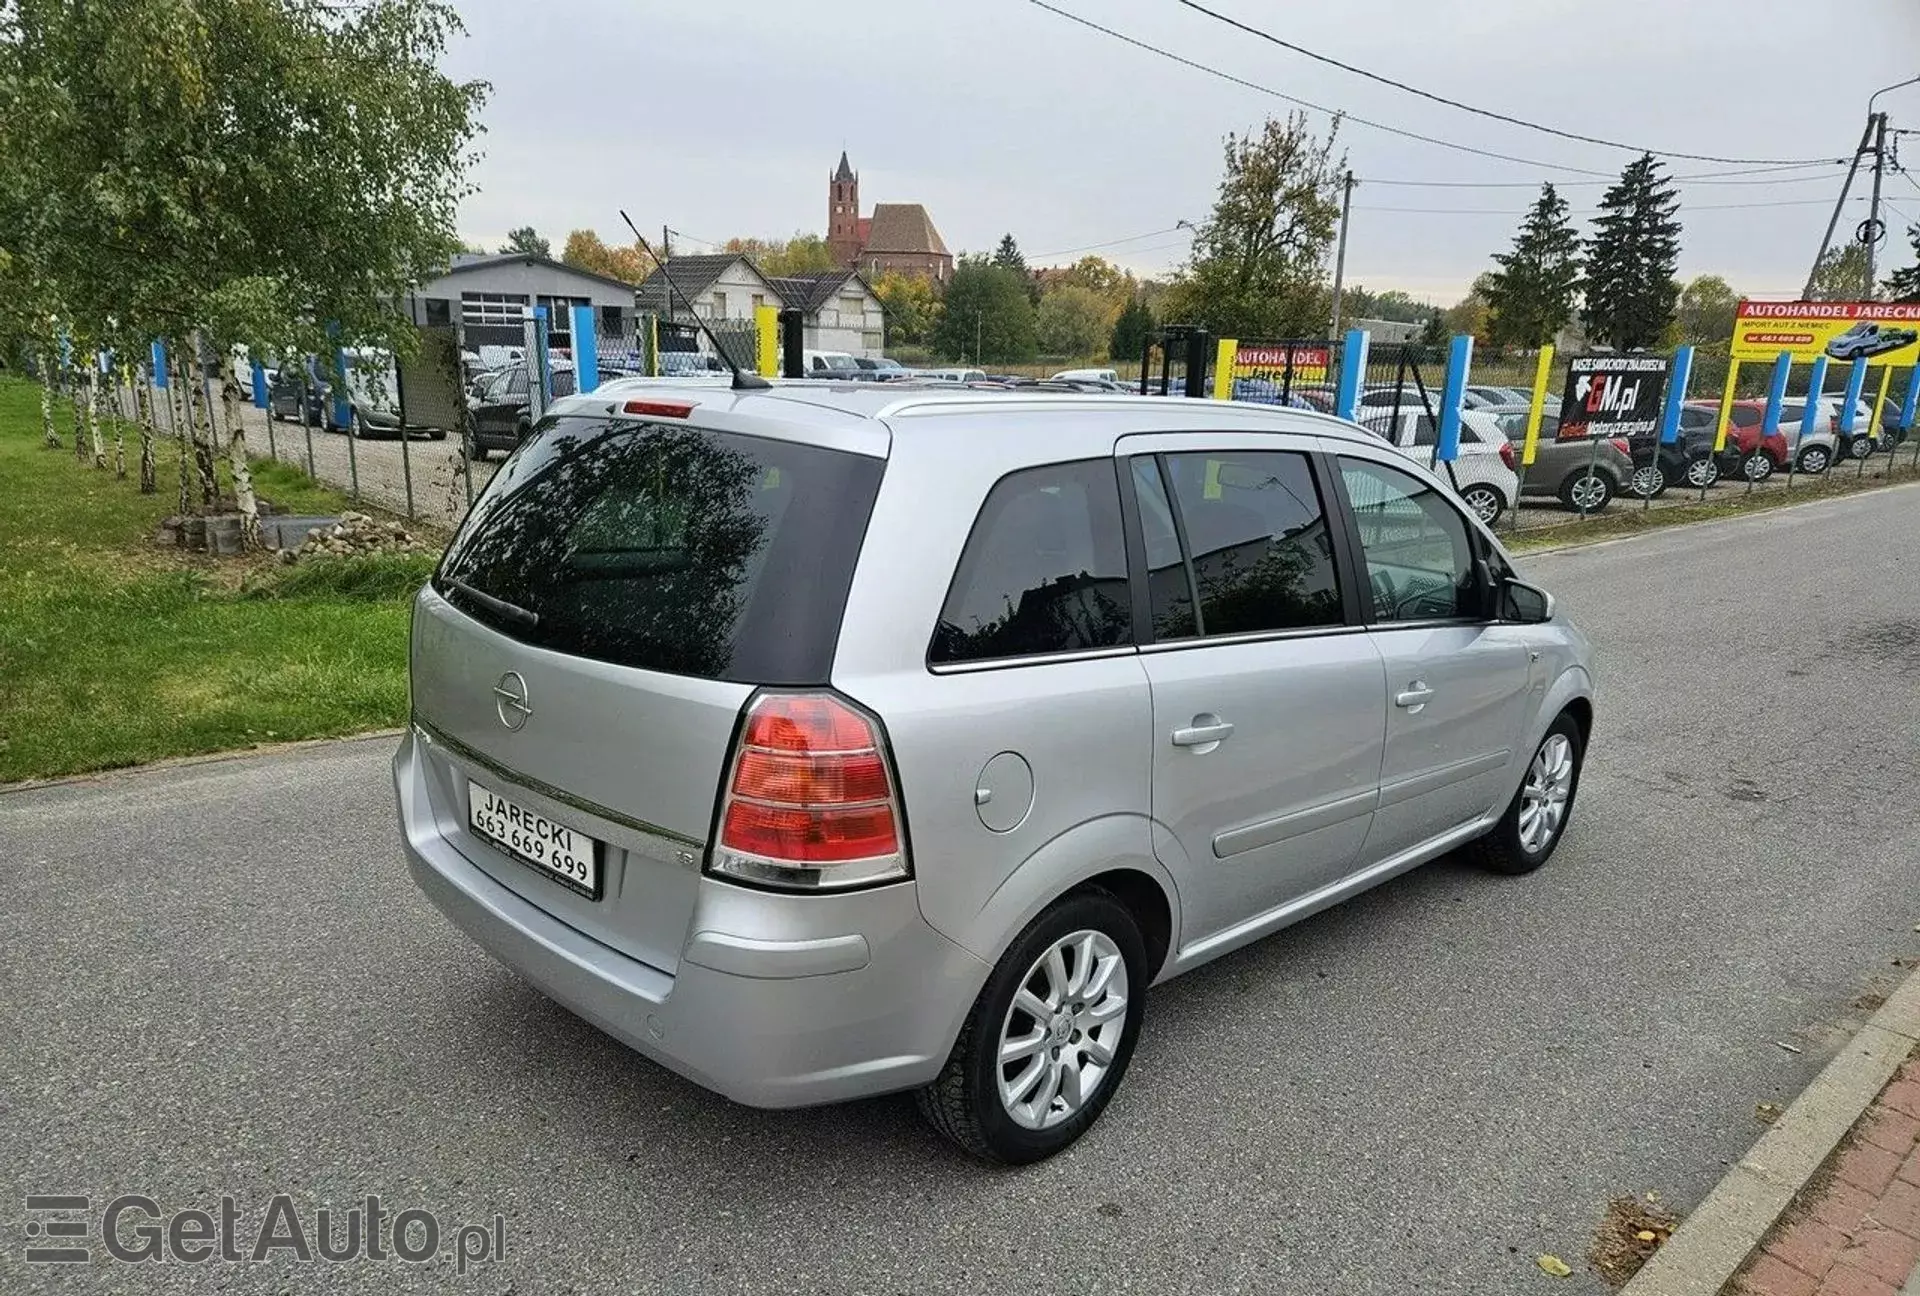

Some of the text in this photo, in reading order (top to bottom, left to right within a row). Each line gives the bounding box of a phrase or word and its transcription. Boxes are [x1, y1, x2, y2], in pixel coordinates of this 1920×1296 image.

[1744, 304, 1920, 319] AUTOHANDEL JARECKI
[476, 809, 506, 839] 663
[511, 829, 545, 859] 669
[551, 852, 588, 881] 699
[484, 793, 573, 852] JARECKI
